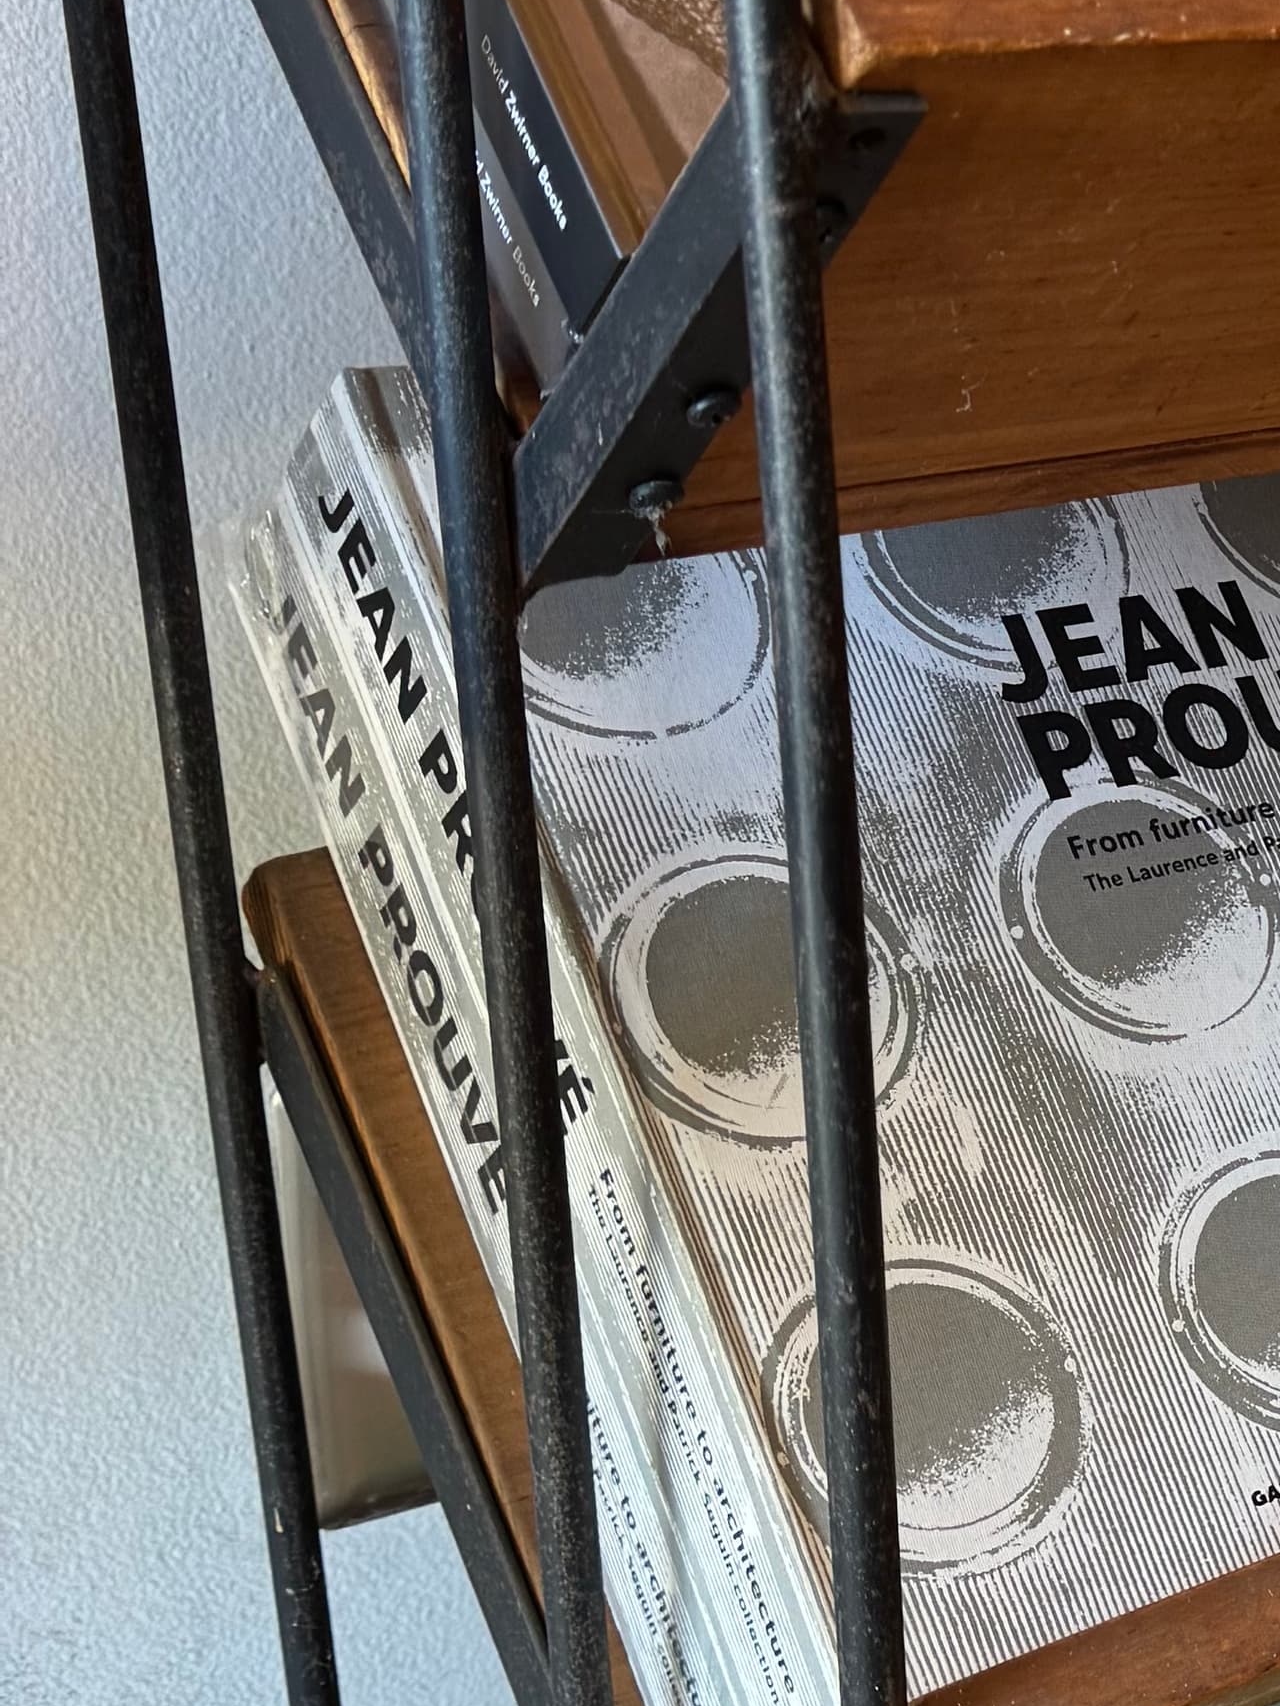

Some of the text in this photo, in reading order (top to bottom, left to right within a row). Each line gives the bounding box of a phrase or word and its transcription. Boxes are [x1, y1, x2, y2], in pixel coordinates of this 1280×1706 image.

[480, 34, 568, 232] David Zwirner Books
[479, 170, 540, 308] Zwirner Books
[318, 487, 428, 726] JEAN
[1001, 580, 1267, 703] JEAN
[1067, 830, 1145, 860] From
[1149, 799, 1275, 844] furniture
[1083, 872, 1123, 893] The
[1127, 850, 1219, 883] Laurence
[1224, 839, 1260, 862] and
[588, 1183, 780, 1705] The Laurence and Patrick Seguin collection
[600, 1168, 795, 1695] From furniture to architecture
[621, 1495, 636, 1530] to
